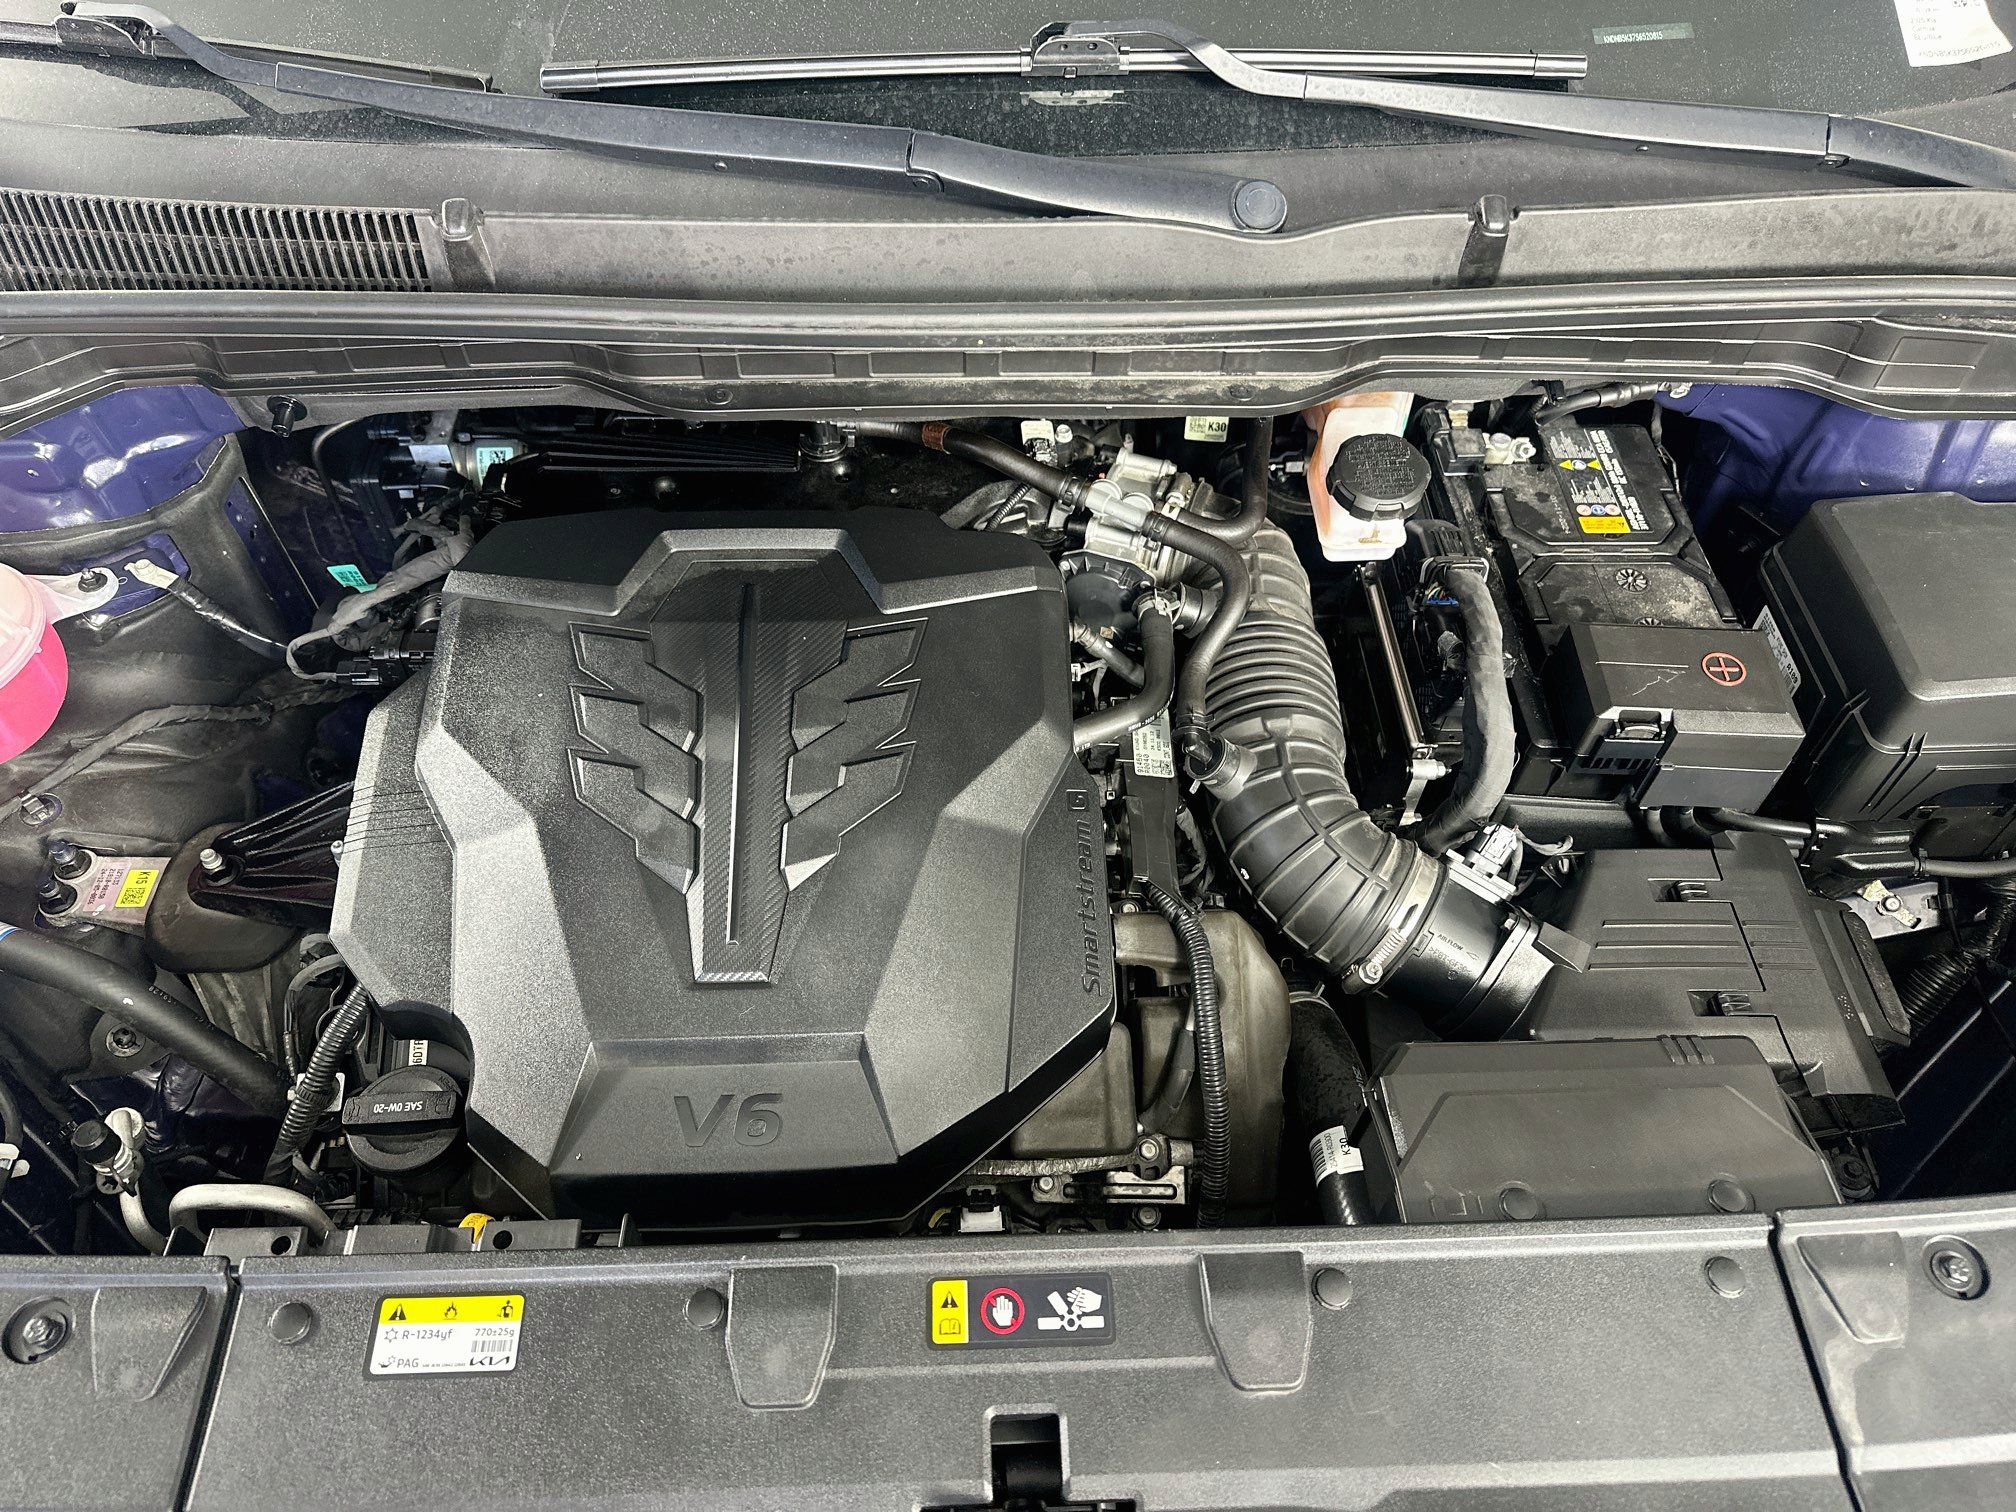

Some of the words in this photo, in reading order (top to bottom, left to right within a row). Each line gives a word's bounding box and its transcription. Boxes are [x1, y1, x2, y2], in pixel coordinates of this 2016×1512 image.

[1207, 421, 1226, 432] K30
[136, 871, 151, 885] K15
[1076, 819, 1102, 997] Smartstream
[1447, 939, 1463, 950] FLOW
[413, 1039, 425, 1065] 6DTR
[373, 1103, 403, 1114] 0W-20
[404, 1100, 423, 1112] SAE
[673, 1092, 783, 1148] V6
[1339, 1137, 1351, 1156] K30
[402, 1328, 453, 1342] R-1234yf
[475, 1327, 515, 1338] 770±25g
[396, 1358, 419, 1368] PAG
